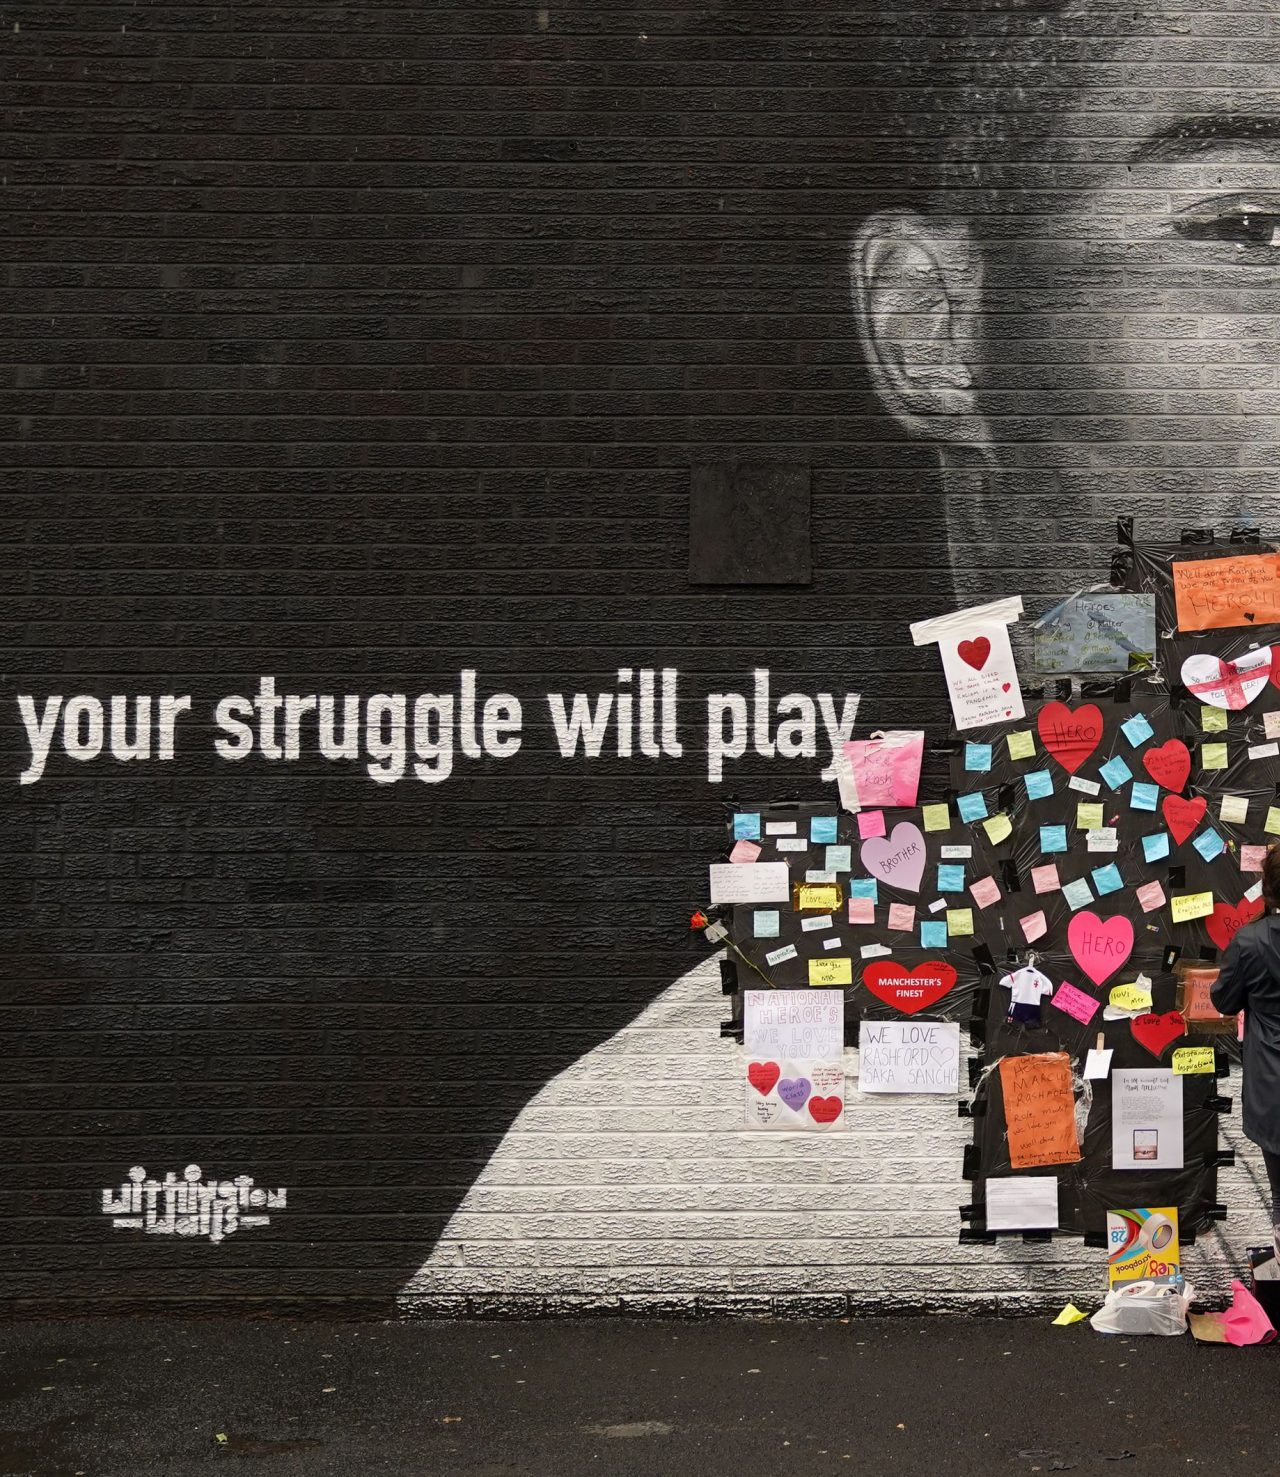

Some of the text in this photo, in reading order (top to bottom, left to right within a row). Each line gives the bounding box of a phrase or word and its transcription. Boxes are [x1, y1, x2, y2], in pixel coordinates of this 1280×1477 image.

[17, 668, 861, 785] your struggle will play
[1052, 722, 1096, 748] HERO
[879, 842, 920, 874] BROTHER
[1082, 931, 1125, 955] HERO
[878, 977, 942, 986] MANCHESTER'S
[748, 990, 843, 1007] NATIONAL
[896, 990, 924, 998] FINEST
[753, 1026, 840, 1044] WE LOVE
[867, 1027, 940, 1044] WE LOVE
[777, 1044, 811, 1059] YOU
[863, 1048, 929, 1067] RASHFORD
[865, 1068, 958, 1085] SAKA SANCHO
[1111, 1230, 1127, 1243] 28
